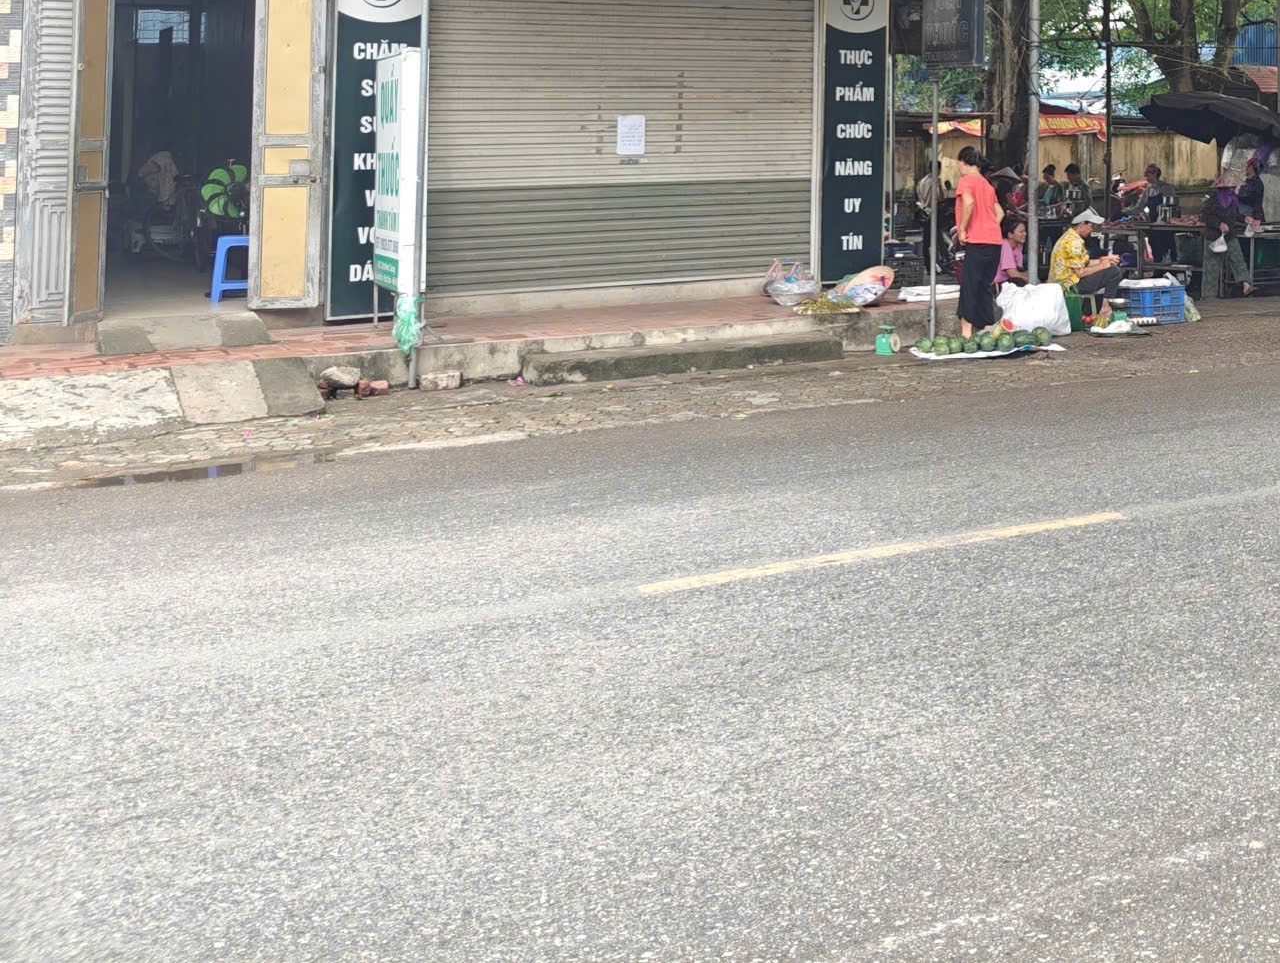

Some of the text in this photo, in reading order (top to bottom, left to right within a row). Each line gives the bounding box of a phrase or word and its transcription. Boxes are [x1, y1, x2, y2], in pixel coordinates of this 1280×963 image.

[839, 48, 873, 67] THỰC
[835, 81, 875, 102] PHẨM
[836, 121, 873, 139] CHỨC
[834, 157, 873, 176] NĂNG
[844, 197, 862, 213] UY
[841, 233, 863, 251] TÍN
